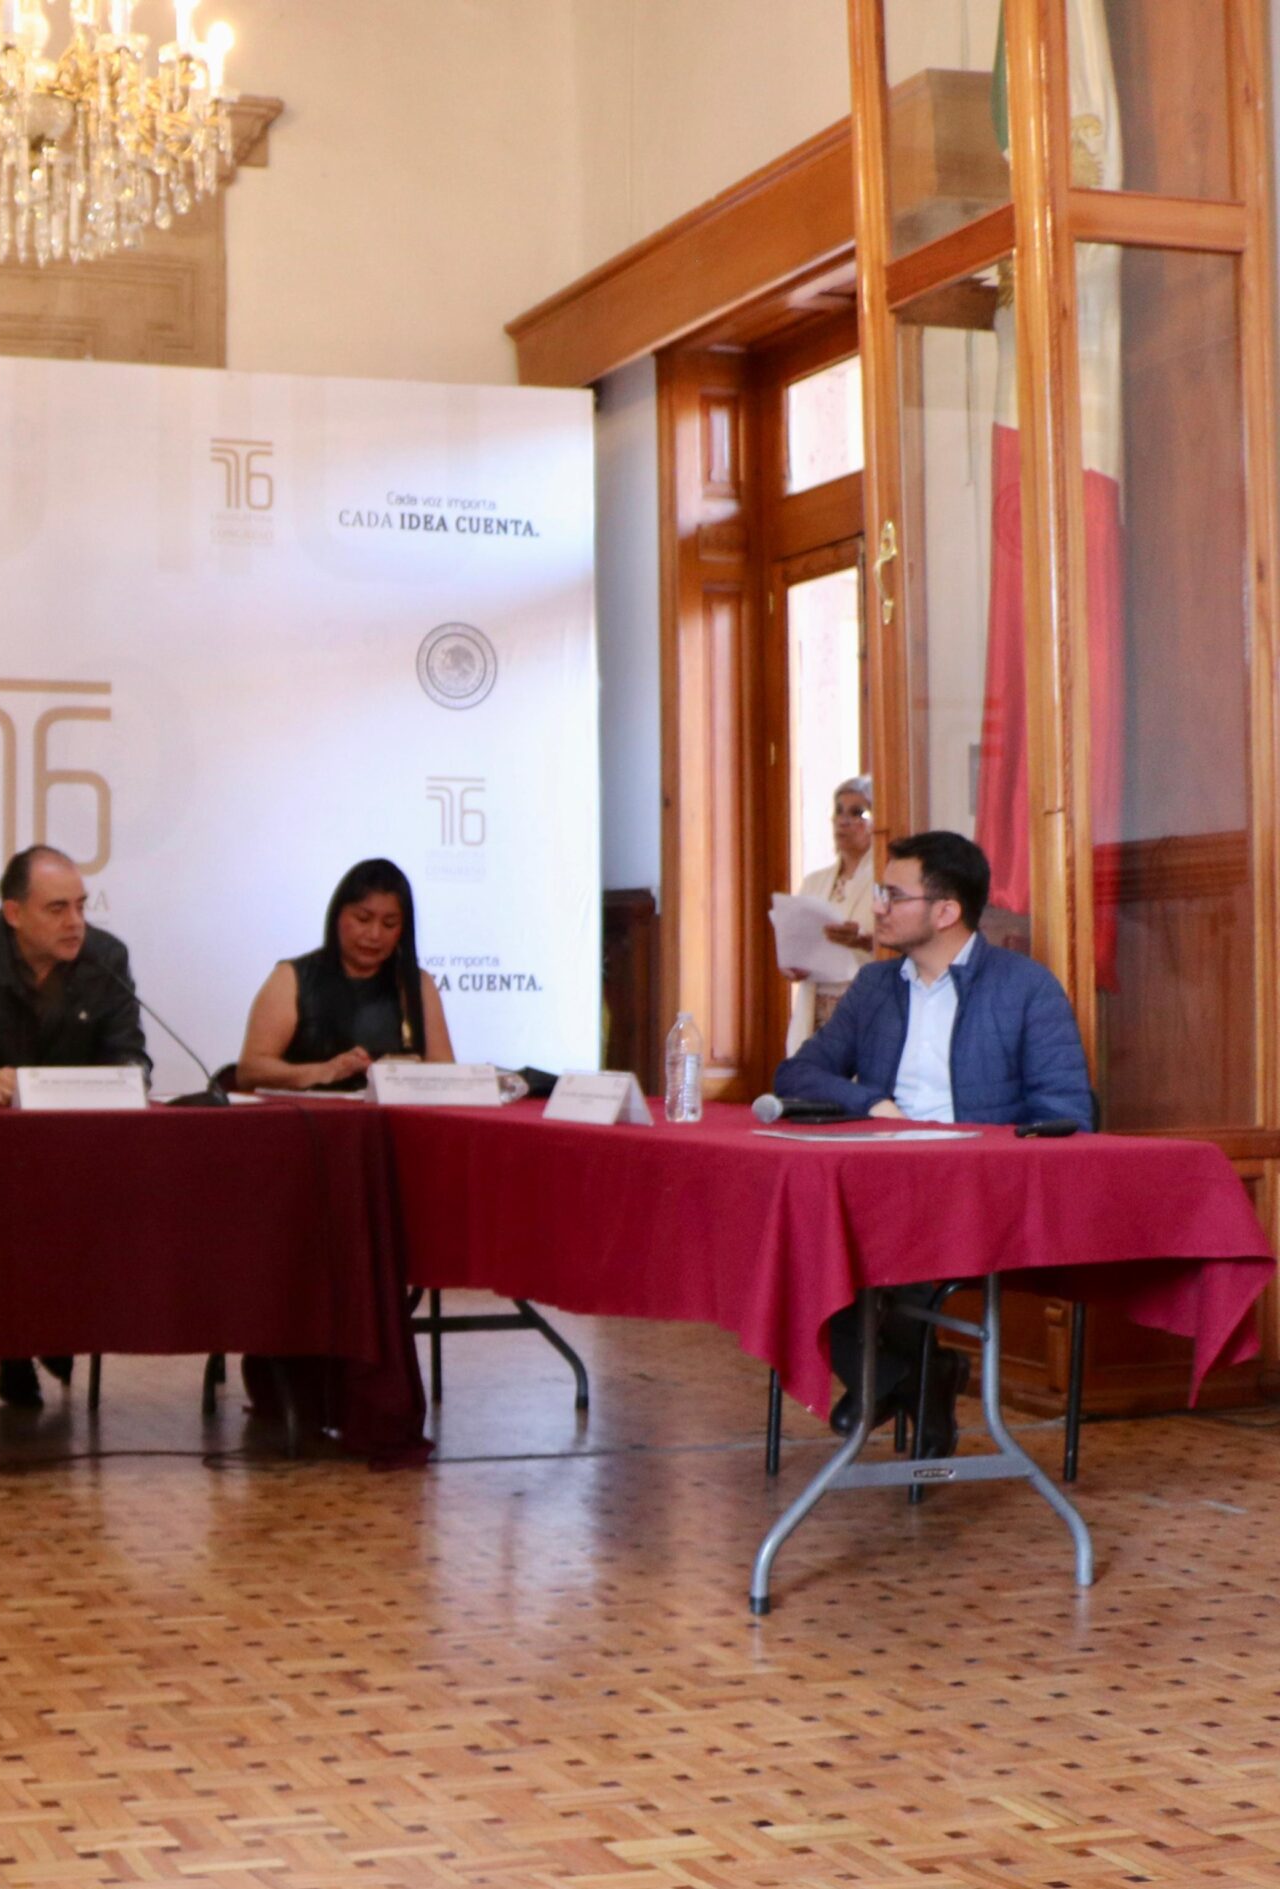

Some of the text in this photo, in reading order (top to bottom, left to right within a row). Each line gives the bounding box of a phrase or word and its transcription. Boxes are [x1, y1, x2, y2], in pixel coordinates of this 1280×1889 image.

[386, 491, 496, 511] Cada voz importa
[338, 509, 541, 538] CADA IDEA CUENTA.
[424, 954, 500, 969] voz importa
[457, 973, 543, 992] CUENTA.
